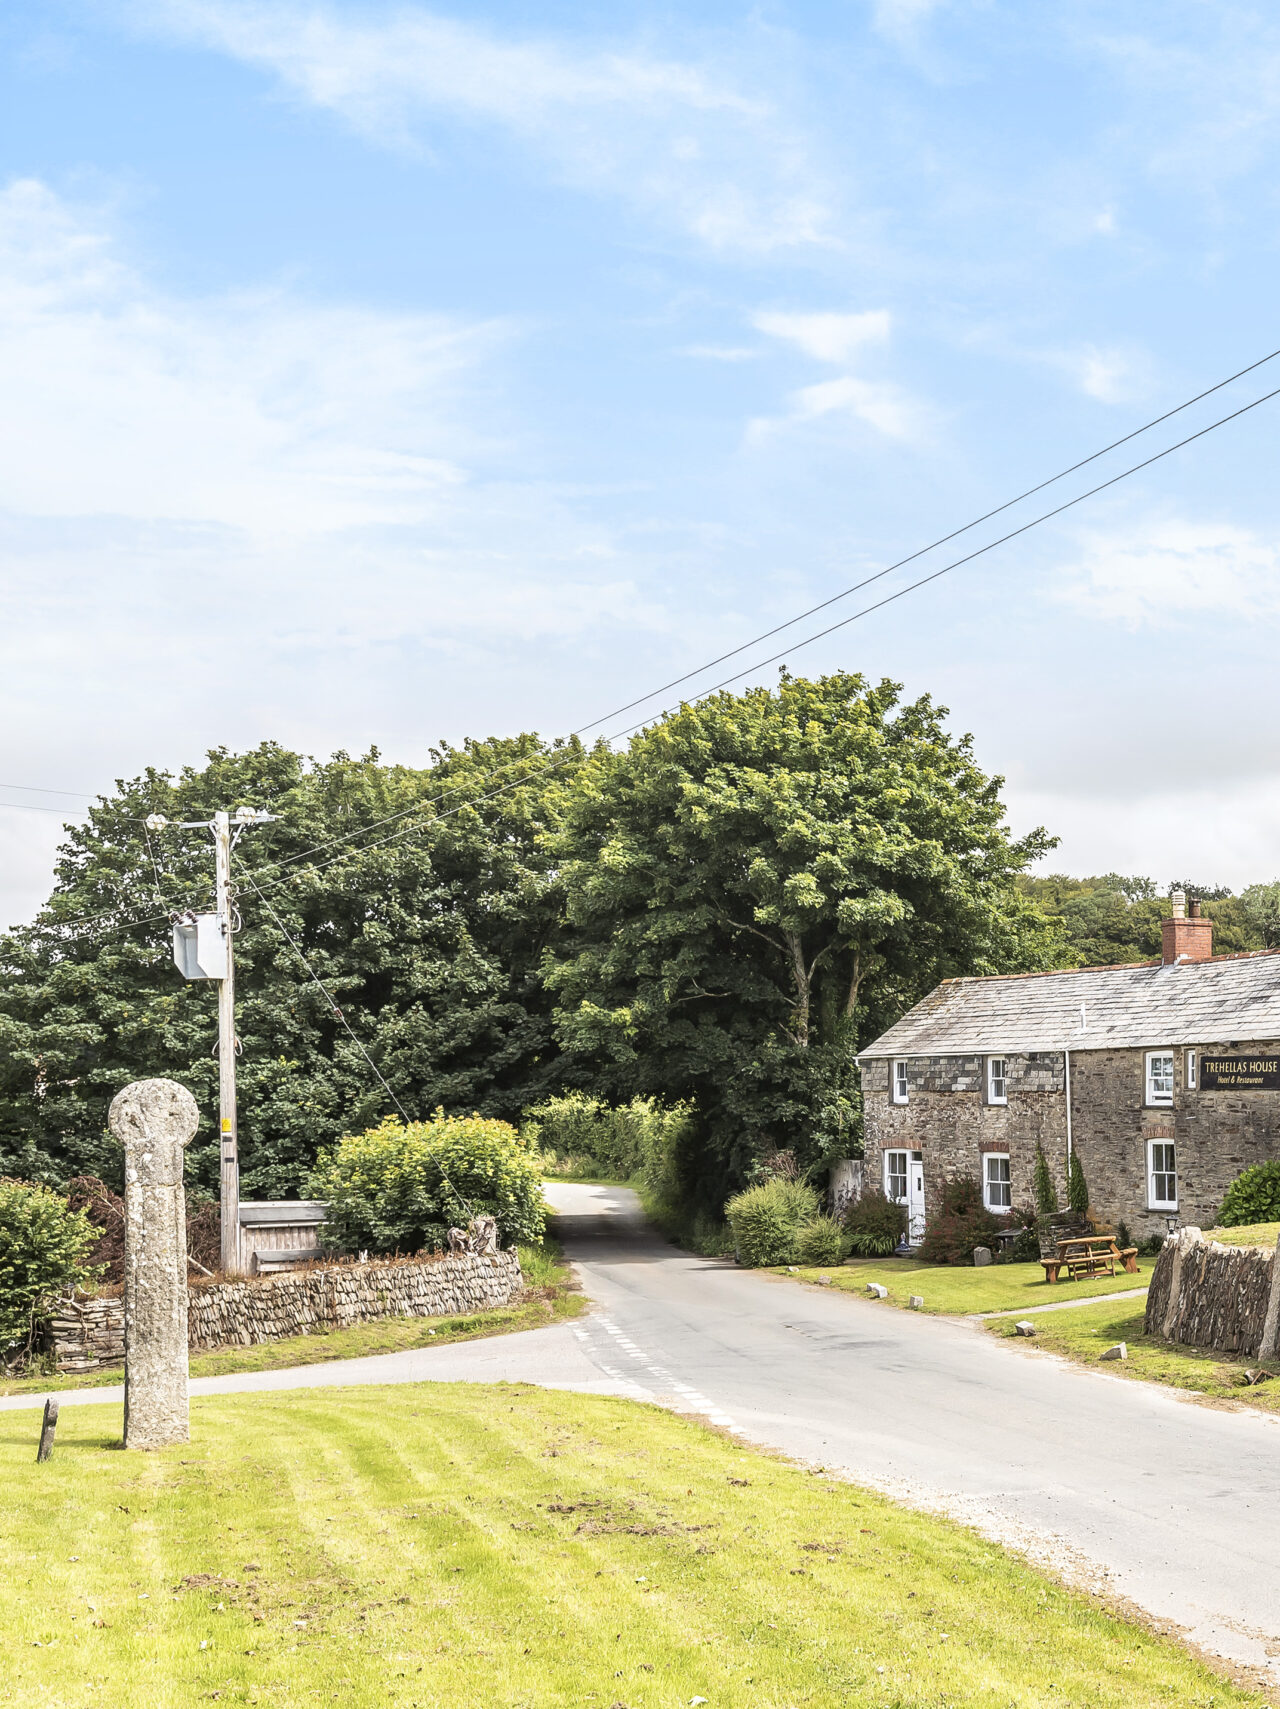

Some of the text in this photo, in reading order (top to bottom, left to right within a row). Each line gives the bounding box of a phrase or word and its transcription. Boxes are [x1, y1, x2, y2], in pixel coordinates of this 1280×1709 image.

[1205, 1061, 1278, 1073] TREHELLAS HOUSE
[1217, 1075, 1231, 1084] Hotel
[1236, 1075, 1264, 1084] Restaurant
